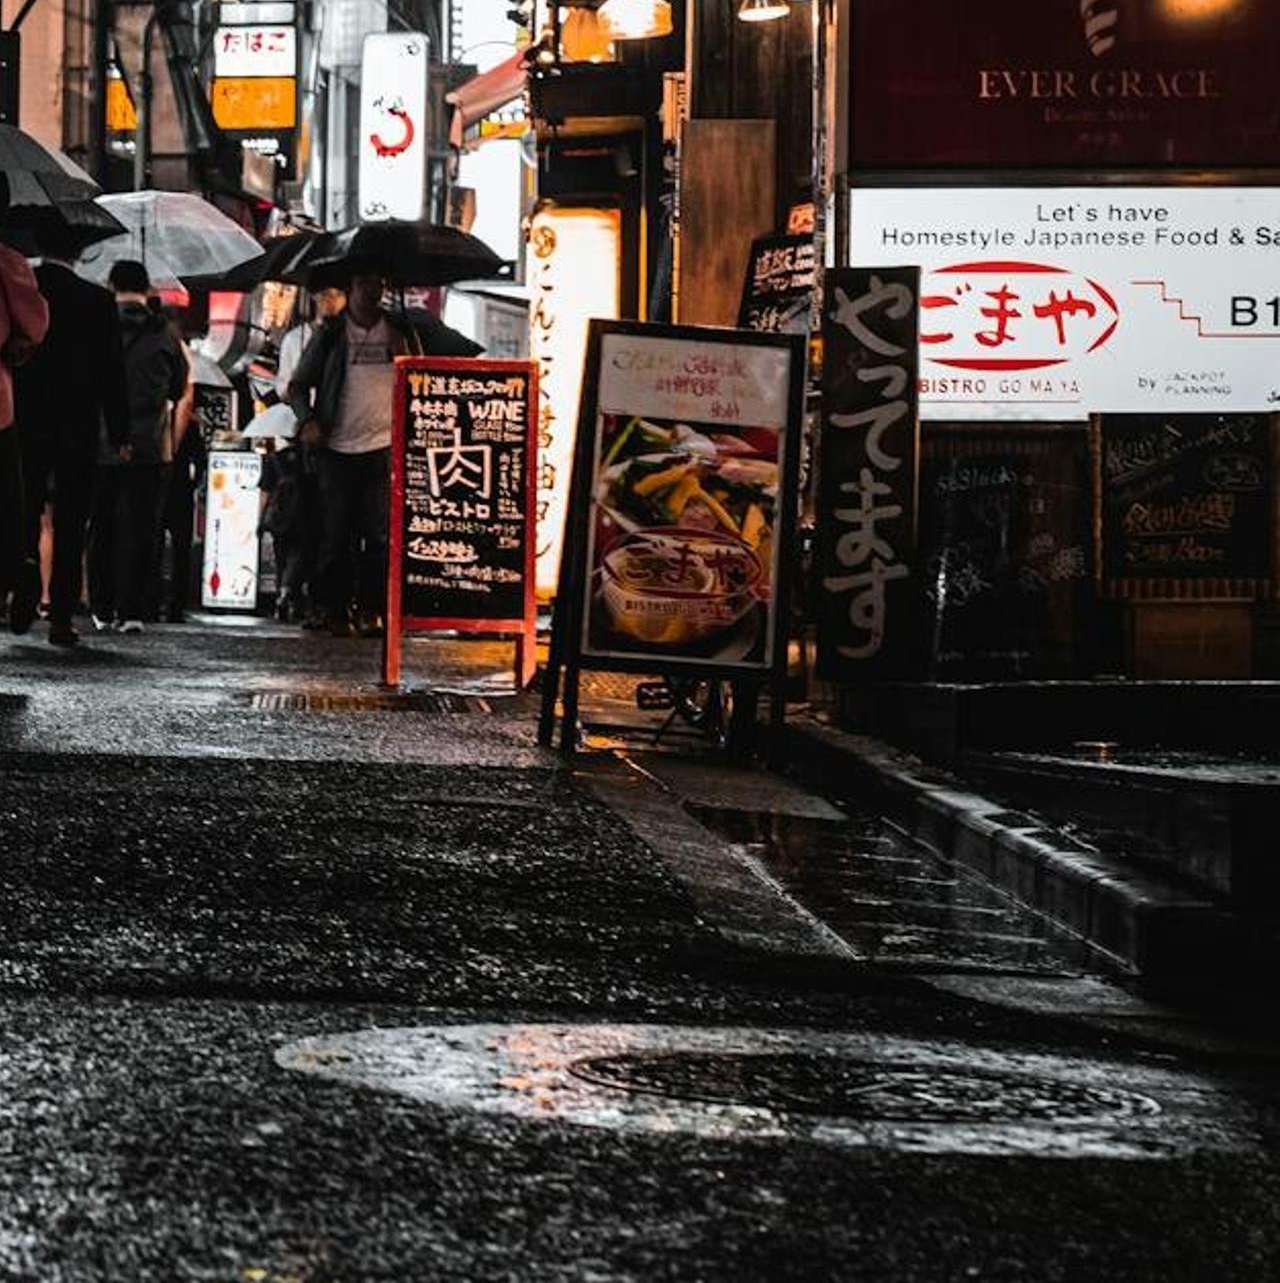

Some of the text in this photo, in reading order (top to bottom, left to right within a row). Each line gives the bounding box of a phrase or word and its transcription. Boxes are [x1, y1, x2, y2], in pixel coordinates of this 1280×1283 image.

[977, 70, 1220, 99] EVER GRACE
[1108, 203, 1170, 223] have
[881, 227, 1016, 251] Homestyle
[1024, 227, 1146, 251] Japanese
[1155, 227, 1219, 247] Food
[1228, 227, 1245, 246] &
[919, 281, 1097, 348] ごまや
[918, 378, 988, 395] BISTRO
[998, 378, 1022, 395] GO
[467, 399, 526, 421] WINE
[426, 426, 492, 499] 肉
[822, 274, 915, 662] やってます
[429, 498, 491, 519] ビストロ
[622, 538, 752, 587] ごまや
